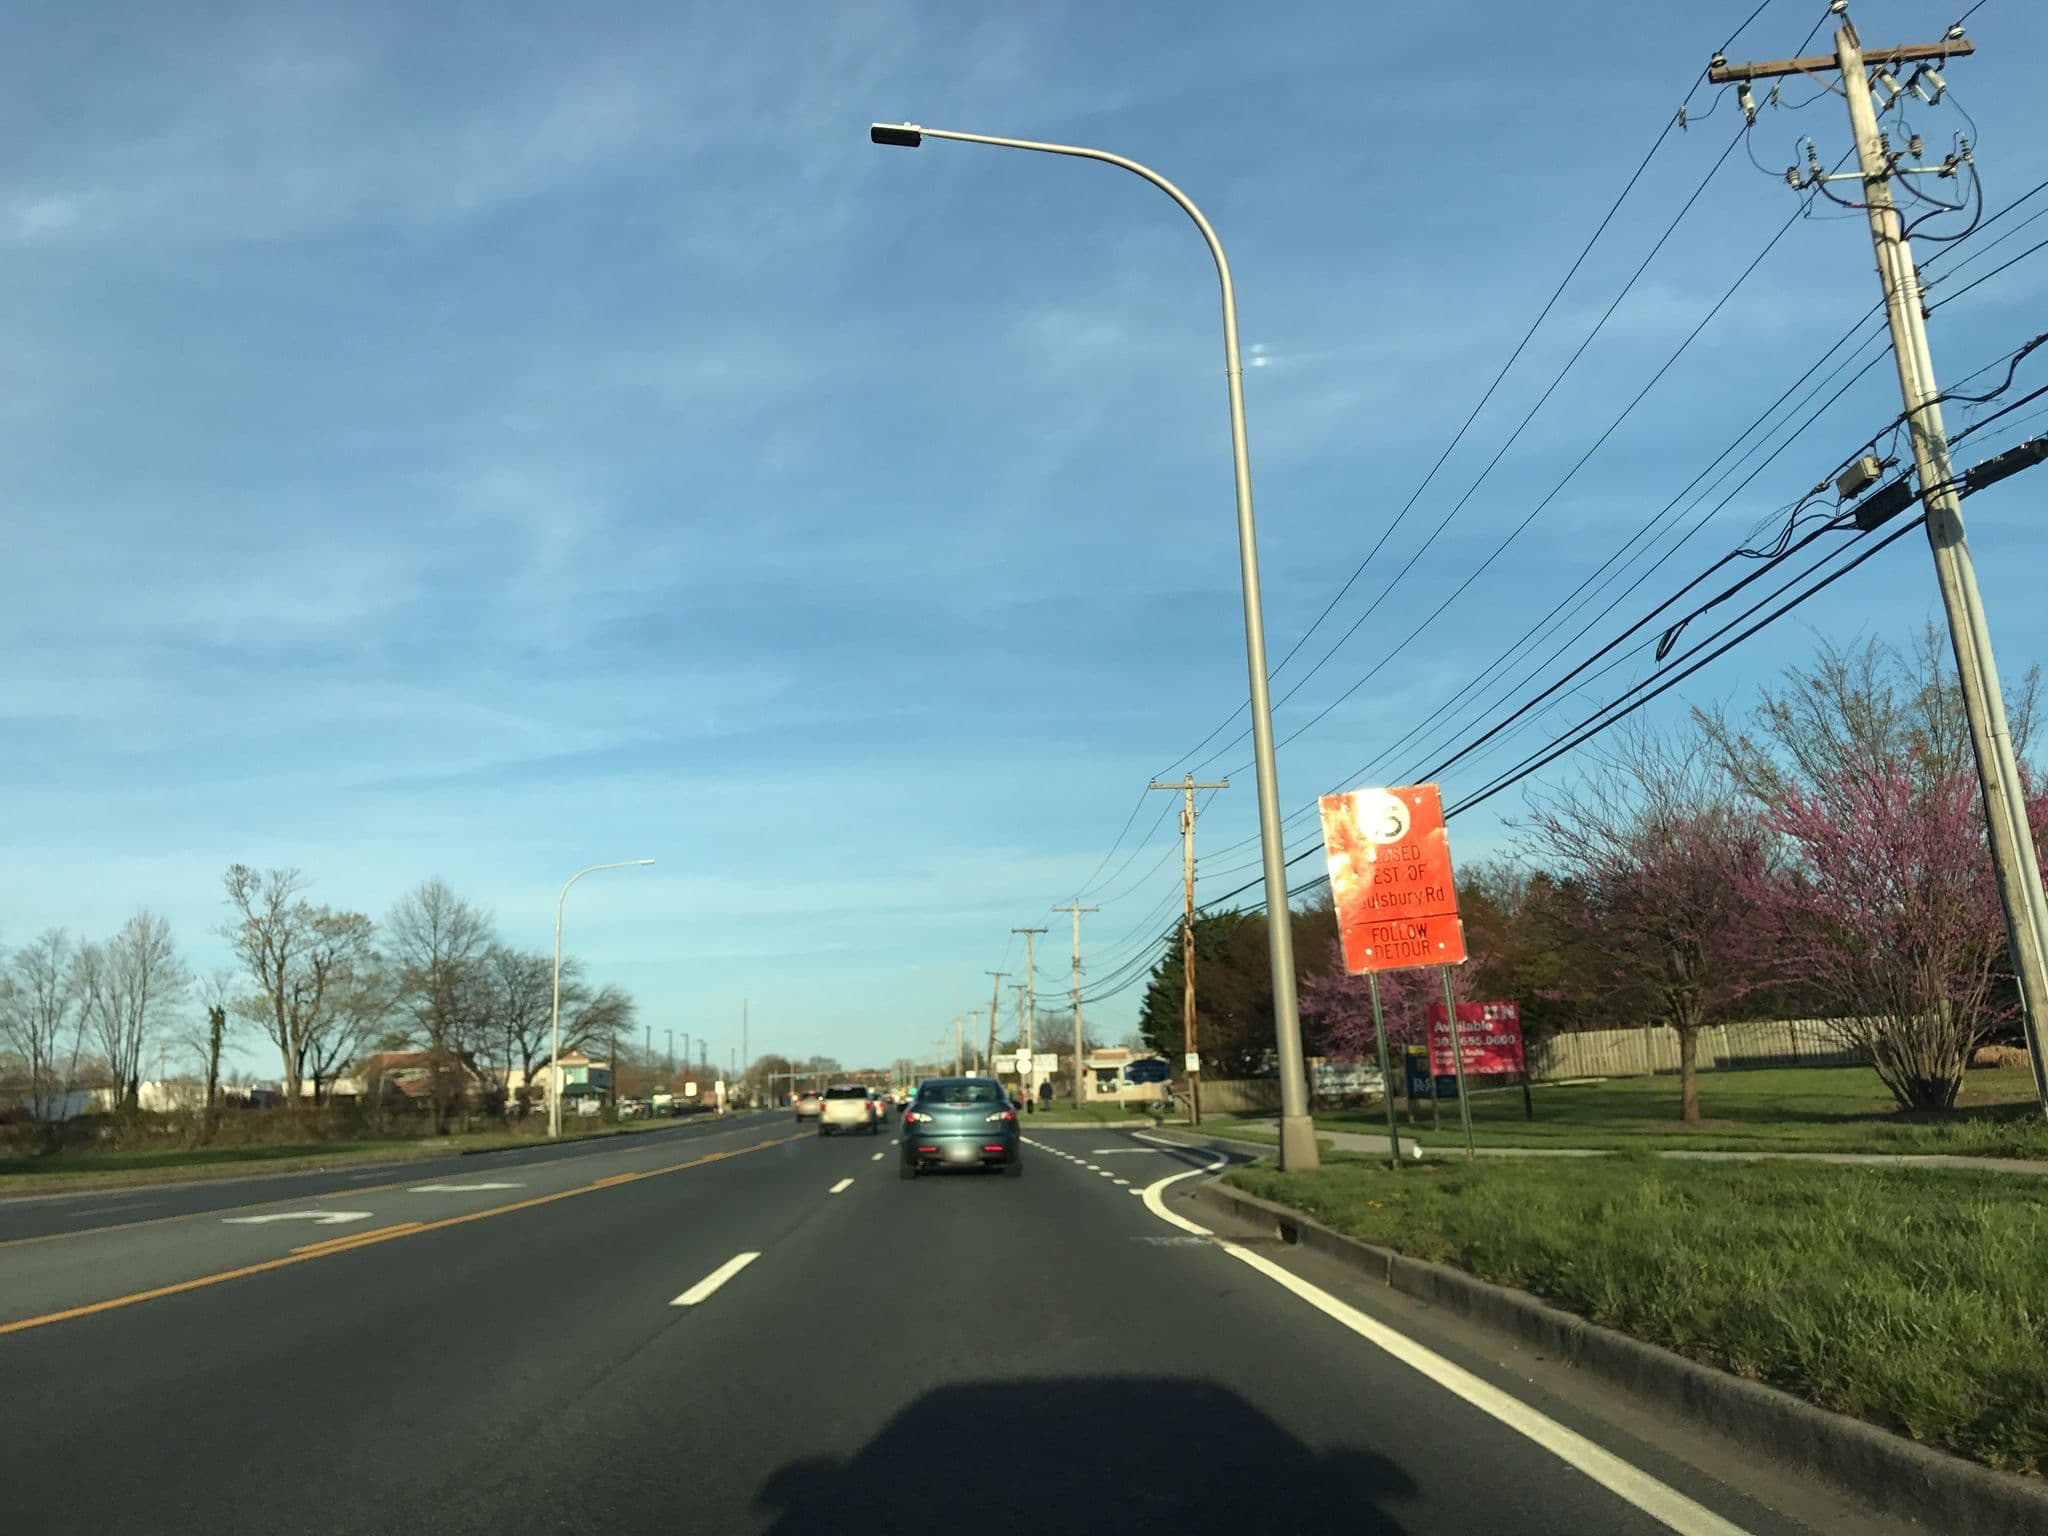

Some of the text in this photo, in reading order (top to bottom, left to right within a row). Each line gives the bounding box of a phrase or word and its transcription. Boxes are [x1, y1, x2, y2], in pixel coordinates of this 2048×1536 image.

[1373, 864, 1426, 885] EST OF
[1361, 885, 1445, 910] ulsbury Rd
[1372, 922, 1427, 943] FOLLOW
[1374, 940, 1431, 961] DETOUR
[1434, 1020, 1494, 1033] Avilable
